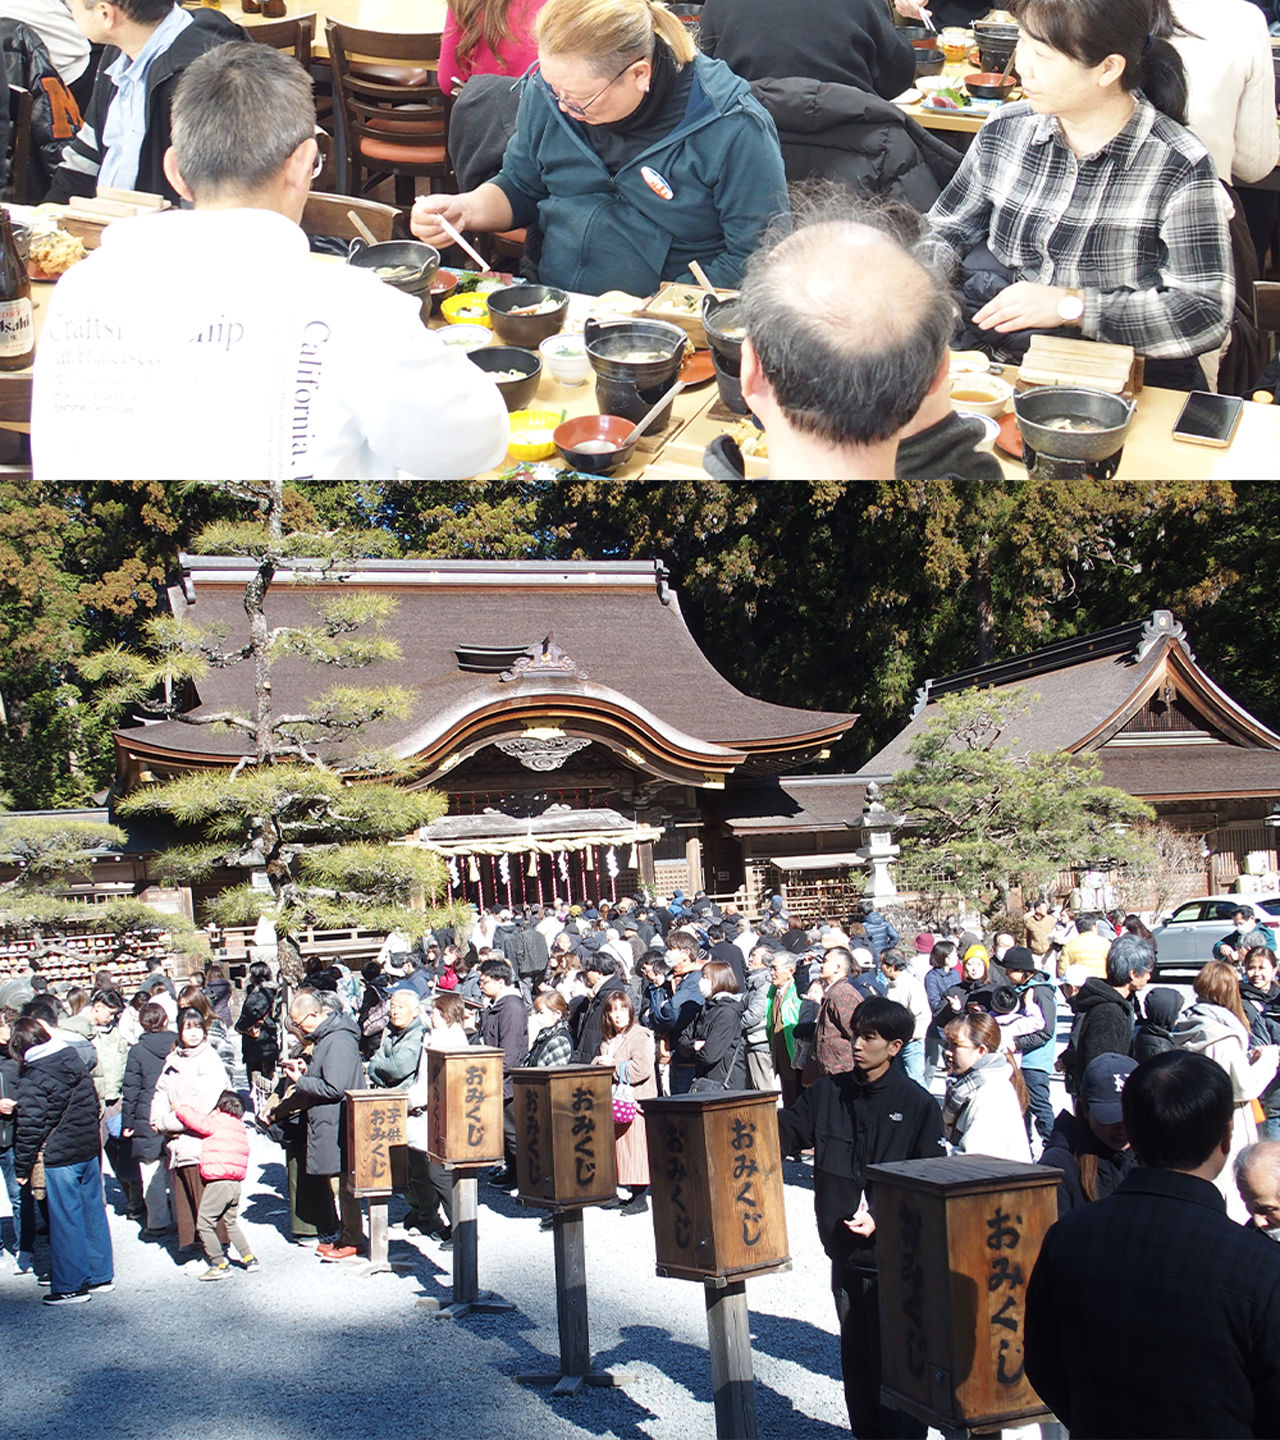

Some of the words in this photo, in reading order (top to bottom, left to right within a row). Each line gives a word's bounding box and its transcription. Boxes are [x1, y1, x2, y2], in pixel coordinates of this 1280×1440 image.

[370, 1109, 389, 1179] おみくじ
[386, 1107, 403, 1142] 子供
[465, 1065, 487, 1147] おみくじ
[571, 1087, 596, 1186] おみくじ
[666, 1122, 692, 1249] おみくじ
[731, 1118, 763, 1246] おみくじ
[986, 1207, 1025, 1385] おみくじ
